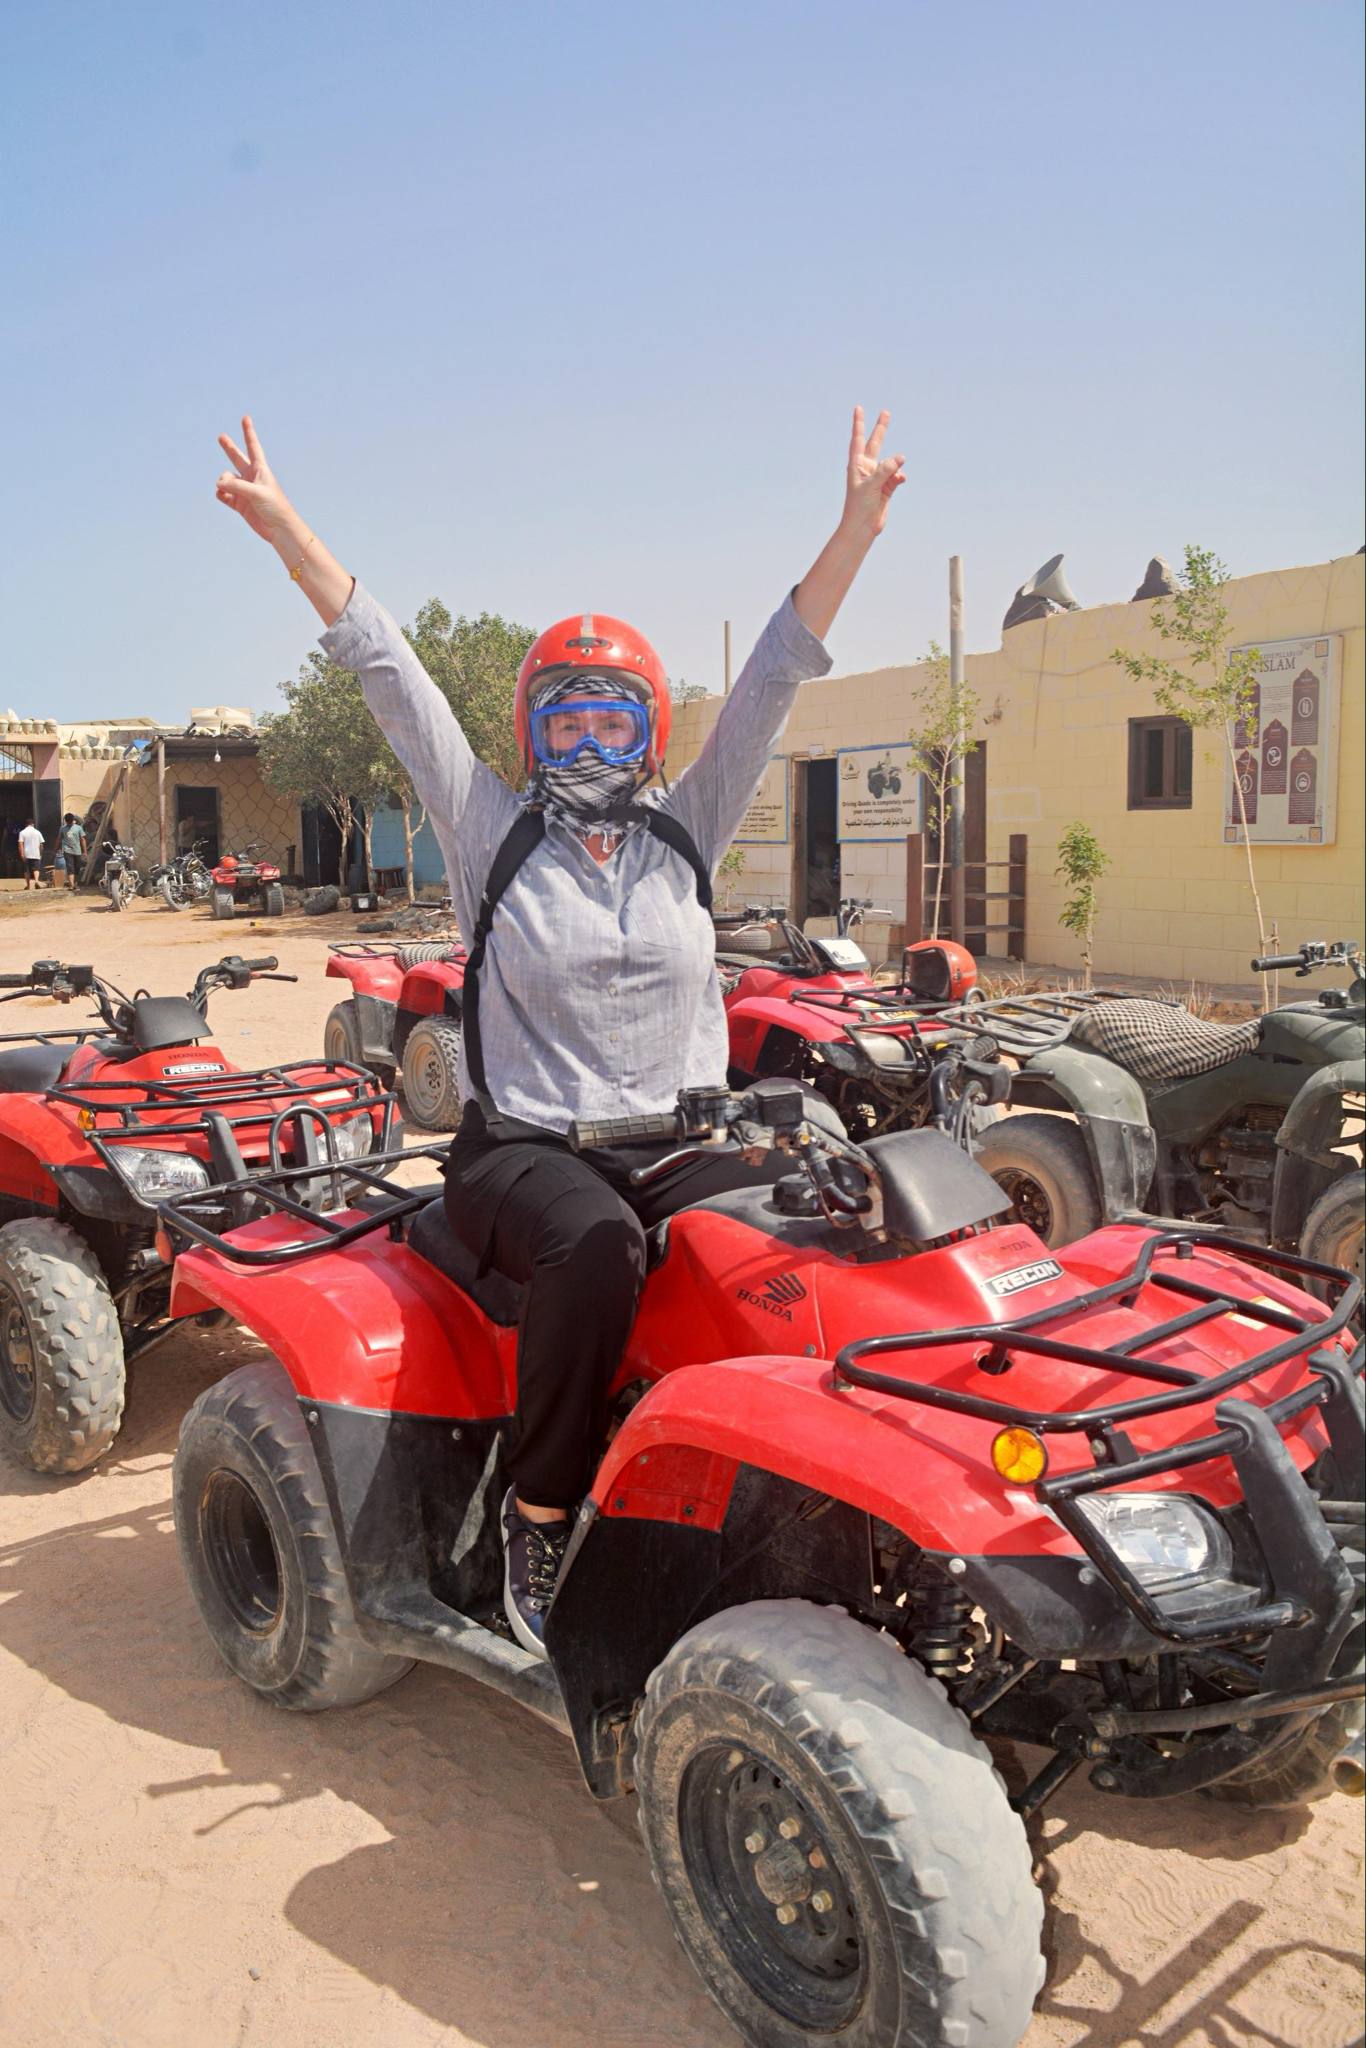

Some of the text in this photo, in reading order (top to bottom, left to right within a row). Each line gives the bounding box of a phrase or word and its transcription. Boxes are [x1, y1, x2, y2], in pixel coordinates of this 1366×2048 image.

[1260, 656, 1296, 673] ISLAM
[170, 1064, 220, 1075] RECON
[991, 1260, 1060, 1294] RECON
[736, 1287, 793, 1322] HONDA
